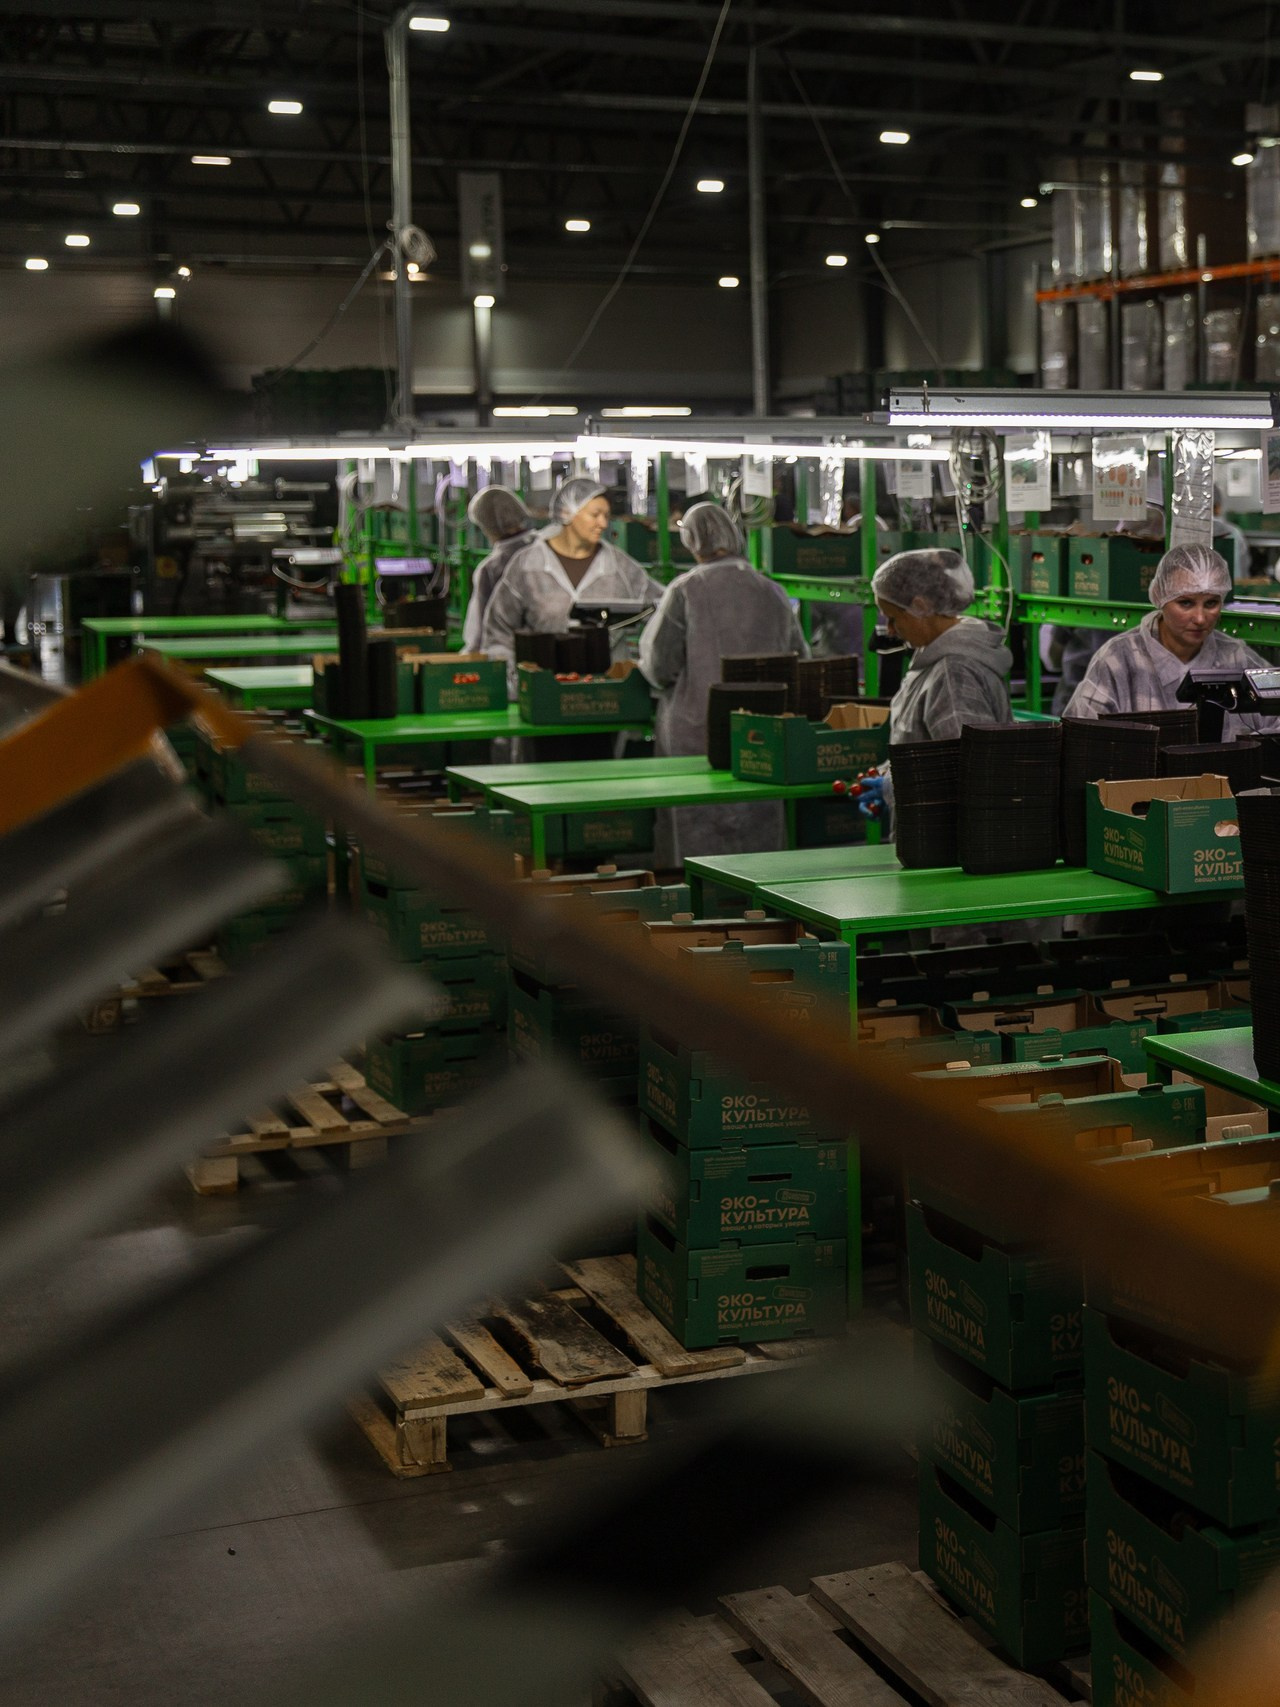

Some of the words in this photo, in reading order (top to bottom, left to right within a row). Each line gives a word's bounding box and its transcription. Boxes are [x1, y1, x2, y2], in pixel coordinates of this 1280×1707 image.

[1104, 826, 1125, 843] ЭКО-
[1104, 842, 1144, 865] КУЛЬТУРА
[1193, 848, 1236, 862] ЭКО-
[1194, 860, 1244, 877] КУЛЬТ
[721, 1094, 769, 1109] ЭКО-
[721, 1106, 809, 1123] КУЛЬТУРА
[720, 1196, 769, 1210] ЭКО-
[720, 1206, 809, 1225] КУЛЬТУРА
[924, 1268, 957, 1300] ЭКО-
[718, 1293, 767, 1308] ЭКО-
[718, 1303, 806, 1323] КУЛЬТУРА
[926, 1295, 985, 1349] КУЛЬТУРА
[1050, 1312, 1081, 1331] ЭК
[1107, 1376, 1152, 1413] ЭКО-
[1108, 1406, 1193, 1474] КУЛЬТУРА
[934, 1516, 966, 1555] ЭКО-
[1106, 1528, 1147, 1576] ЭКО-
[935, 1544, 996, 1615] КУЛЬТУРА
[1108, 1556, 1185, 1642] КУЛЬТУРА
